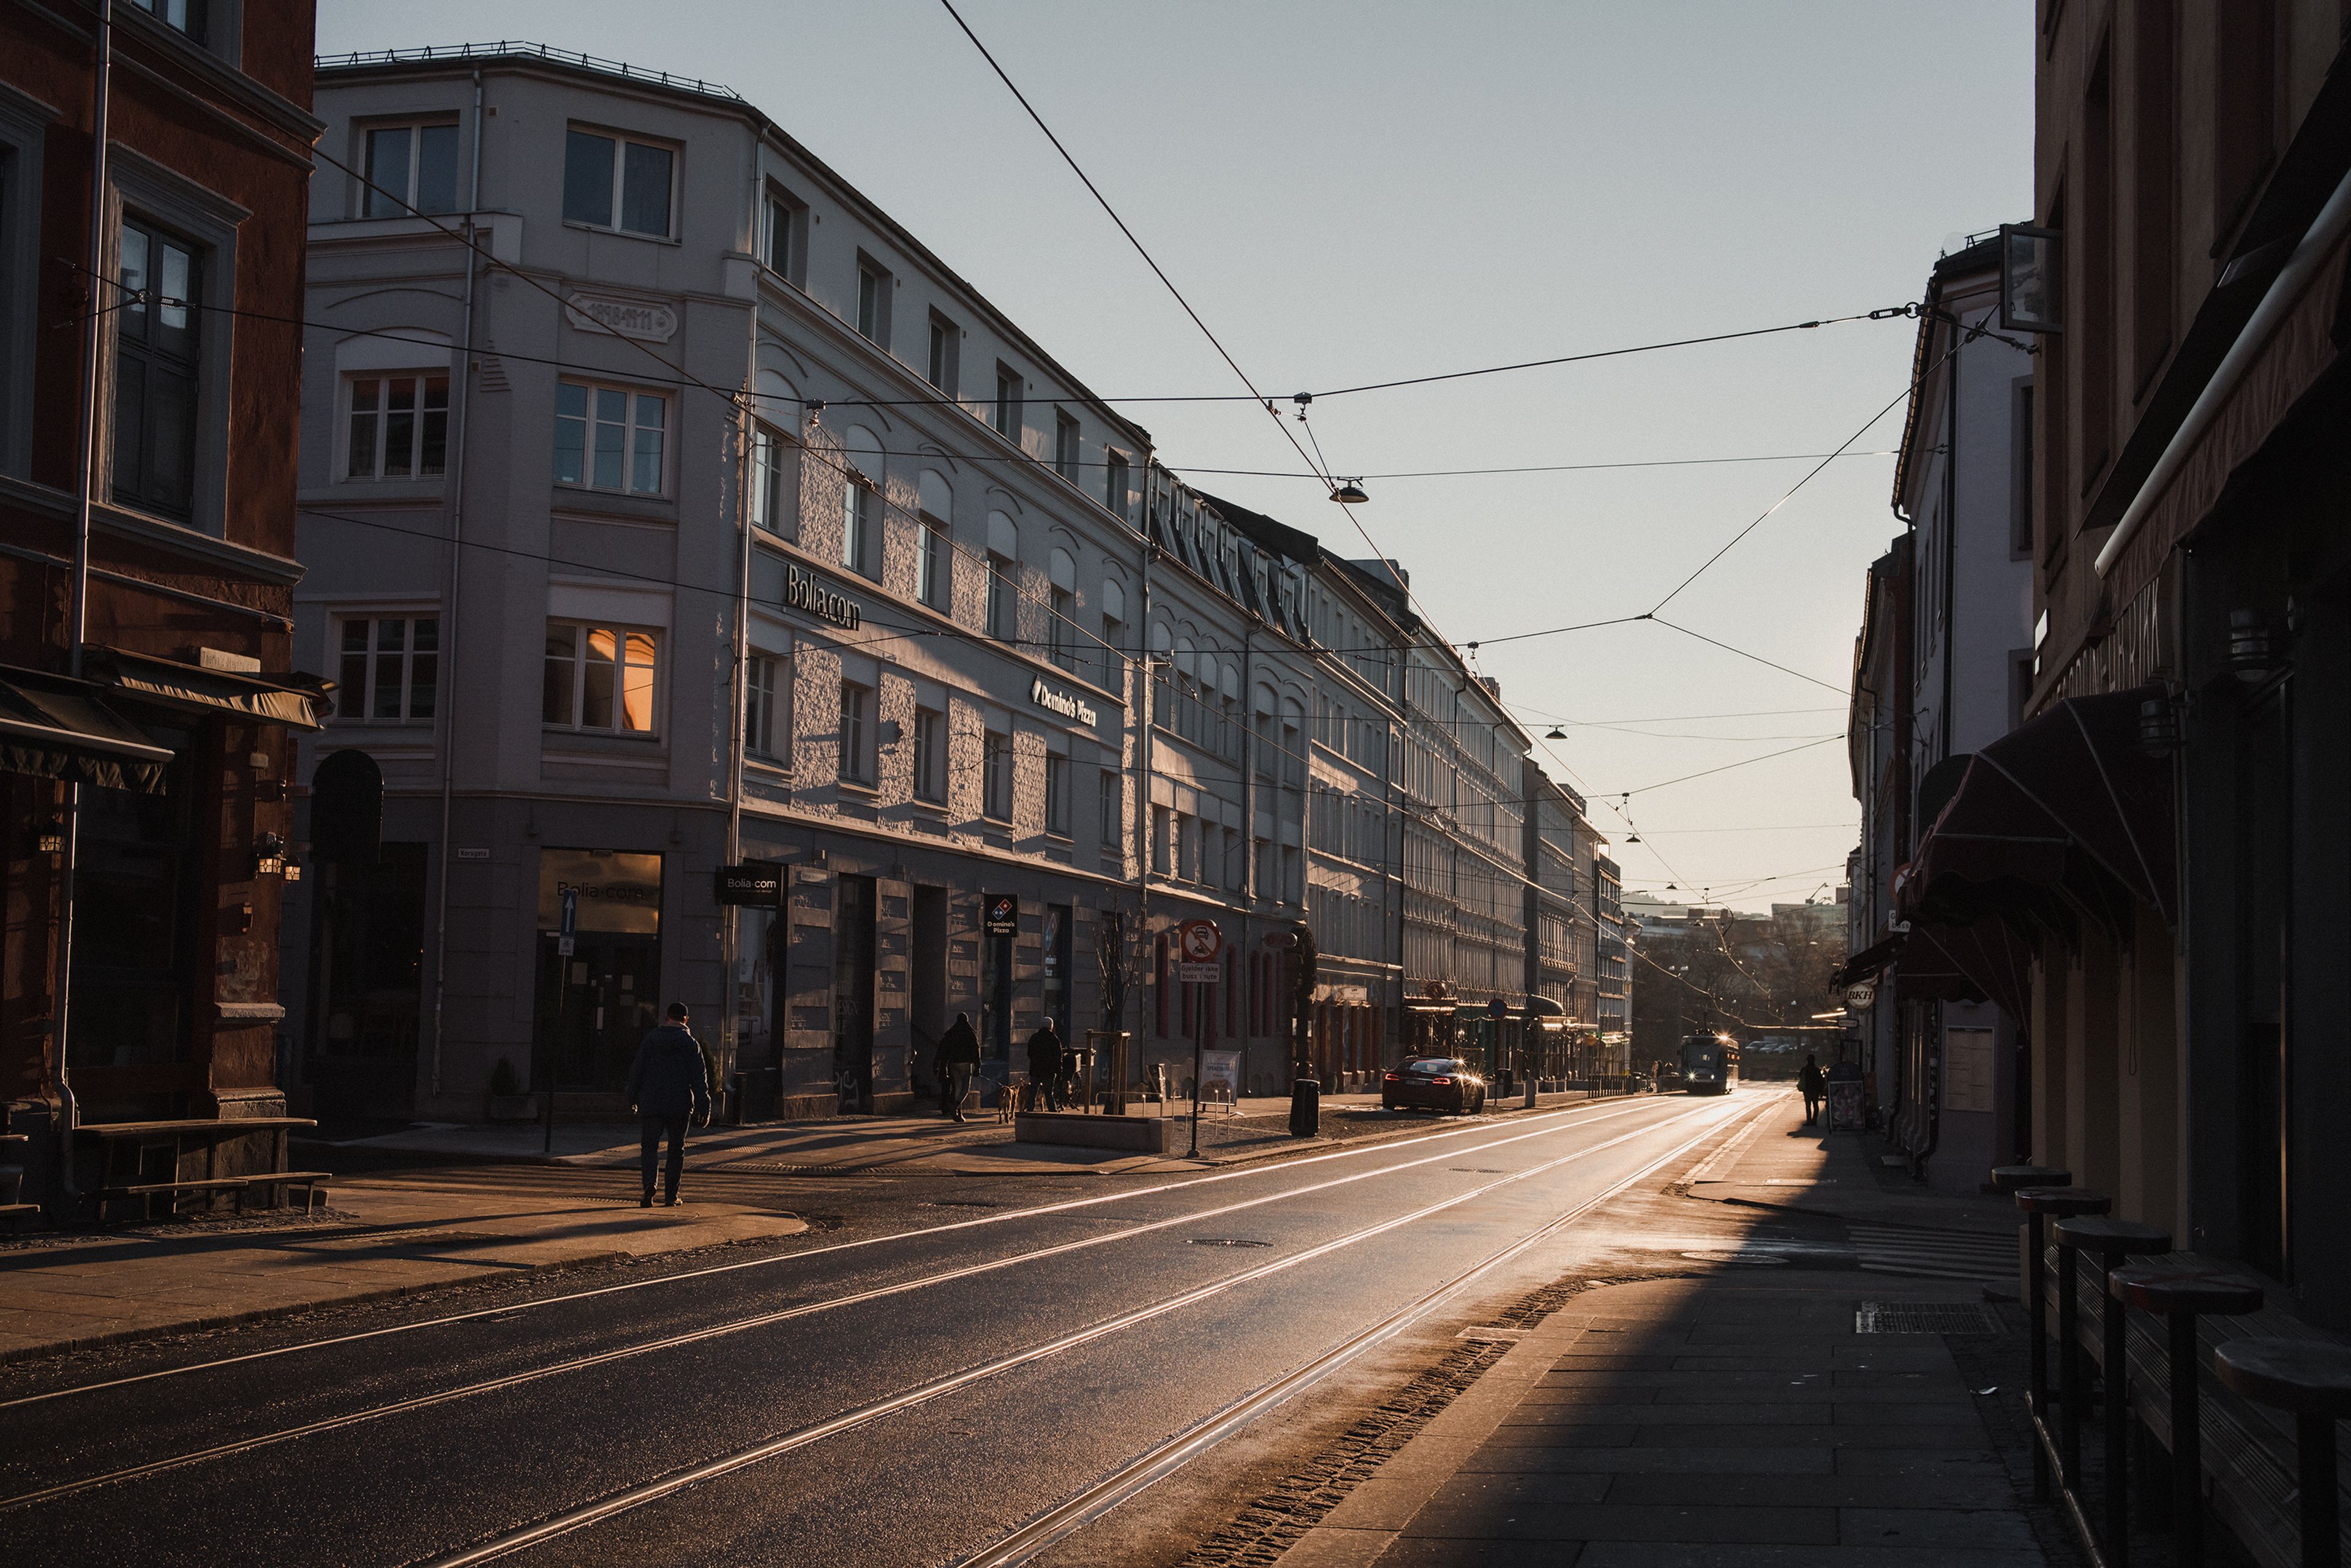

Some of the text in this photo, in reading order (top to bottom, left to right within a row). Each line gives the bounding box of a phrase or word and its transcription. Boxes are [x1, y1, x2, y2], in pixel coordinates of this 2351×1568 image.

[788, 564, 861, 631] Bolia.com
[1041, 684, 1097, 727] Domino's Pizza
